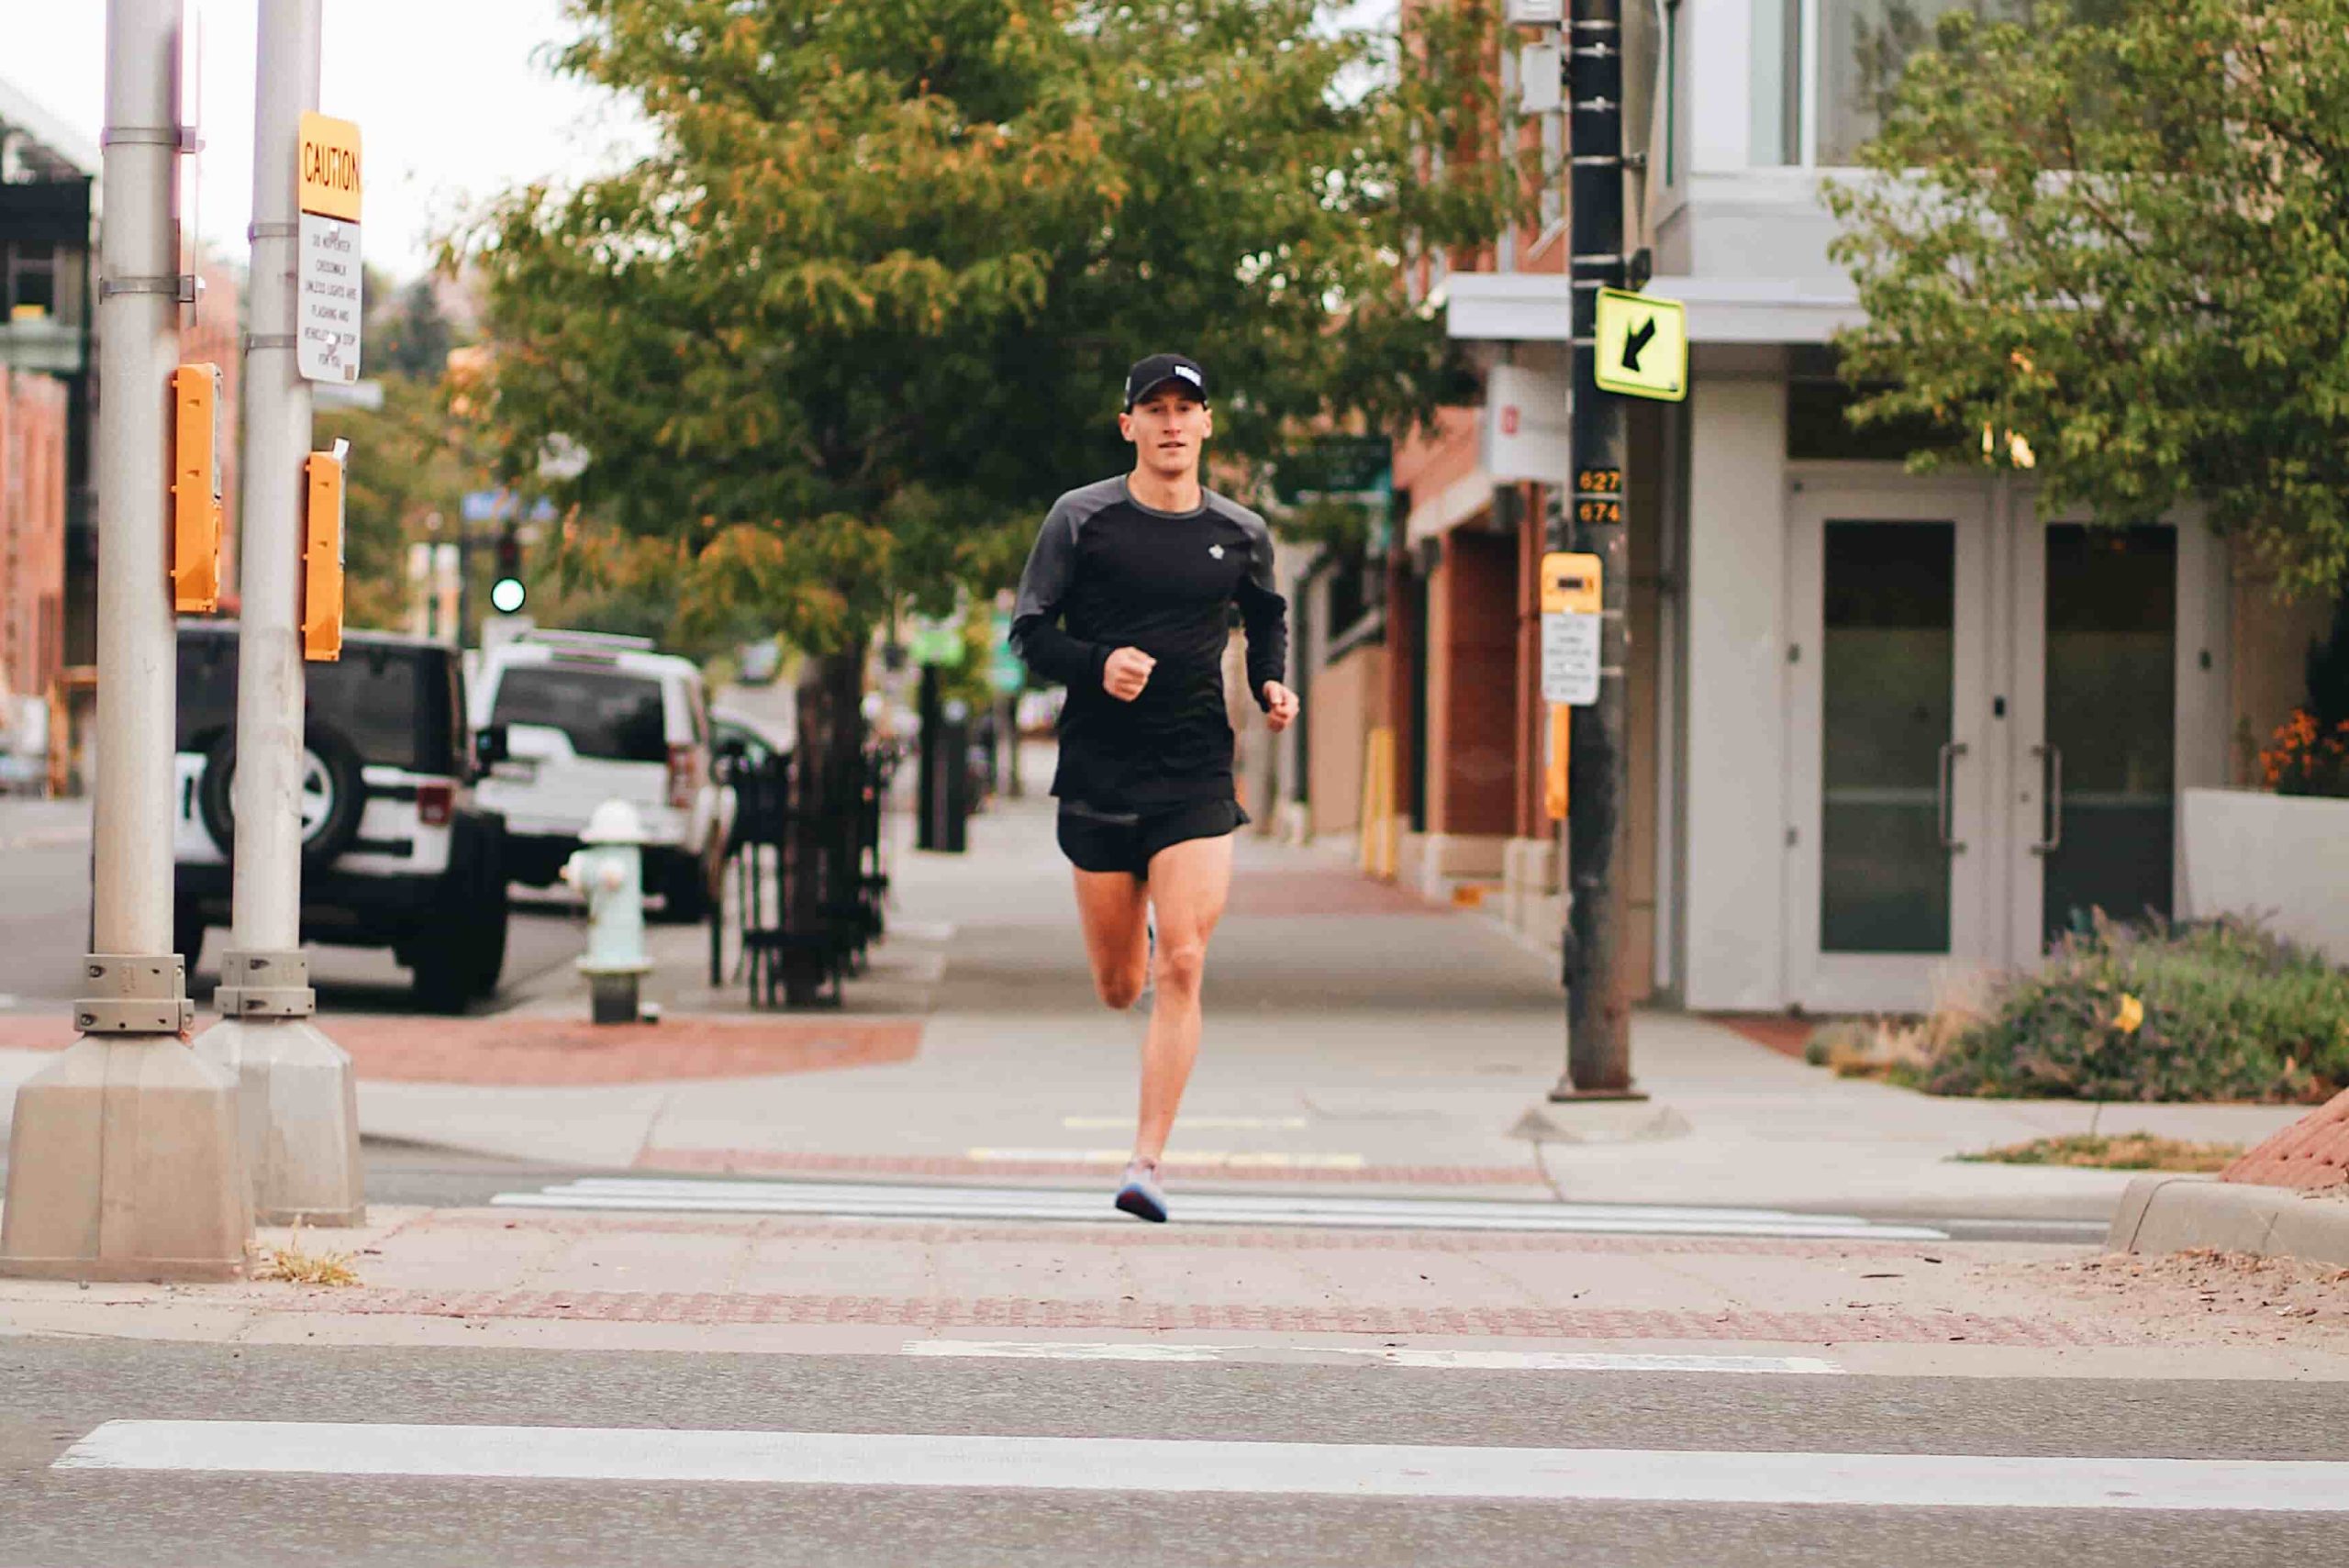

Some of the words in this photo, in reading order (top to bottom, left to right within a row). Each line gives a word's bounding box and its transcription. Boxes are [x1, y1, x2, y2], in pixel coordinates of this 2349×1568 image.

[305, 141, 360, 193] CAUTION
[1580, 471, 1620, 491] 627
[1580, 503, 1620, 522] 674
